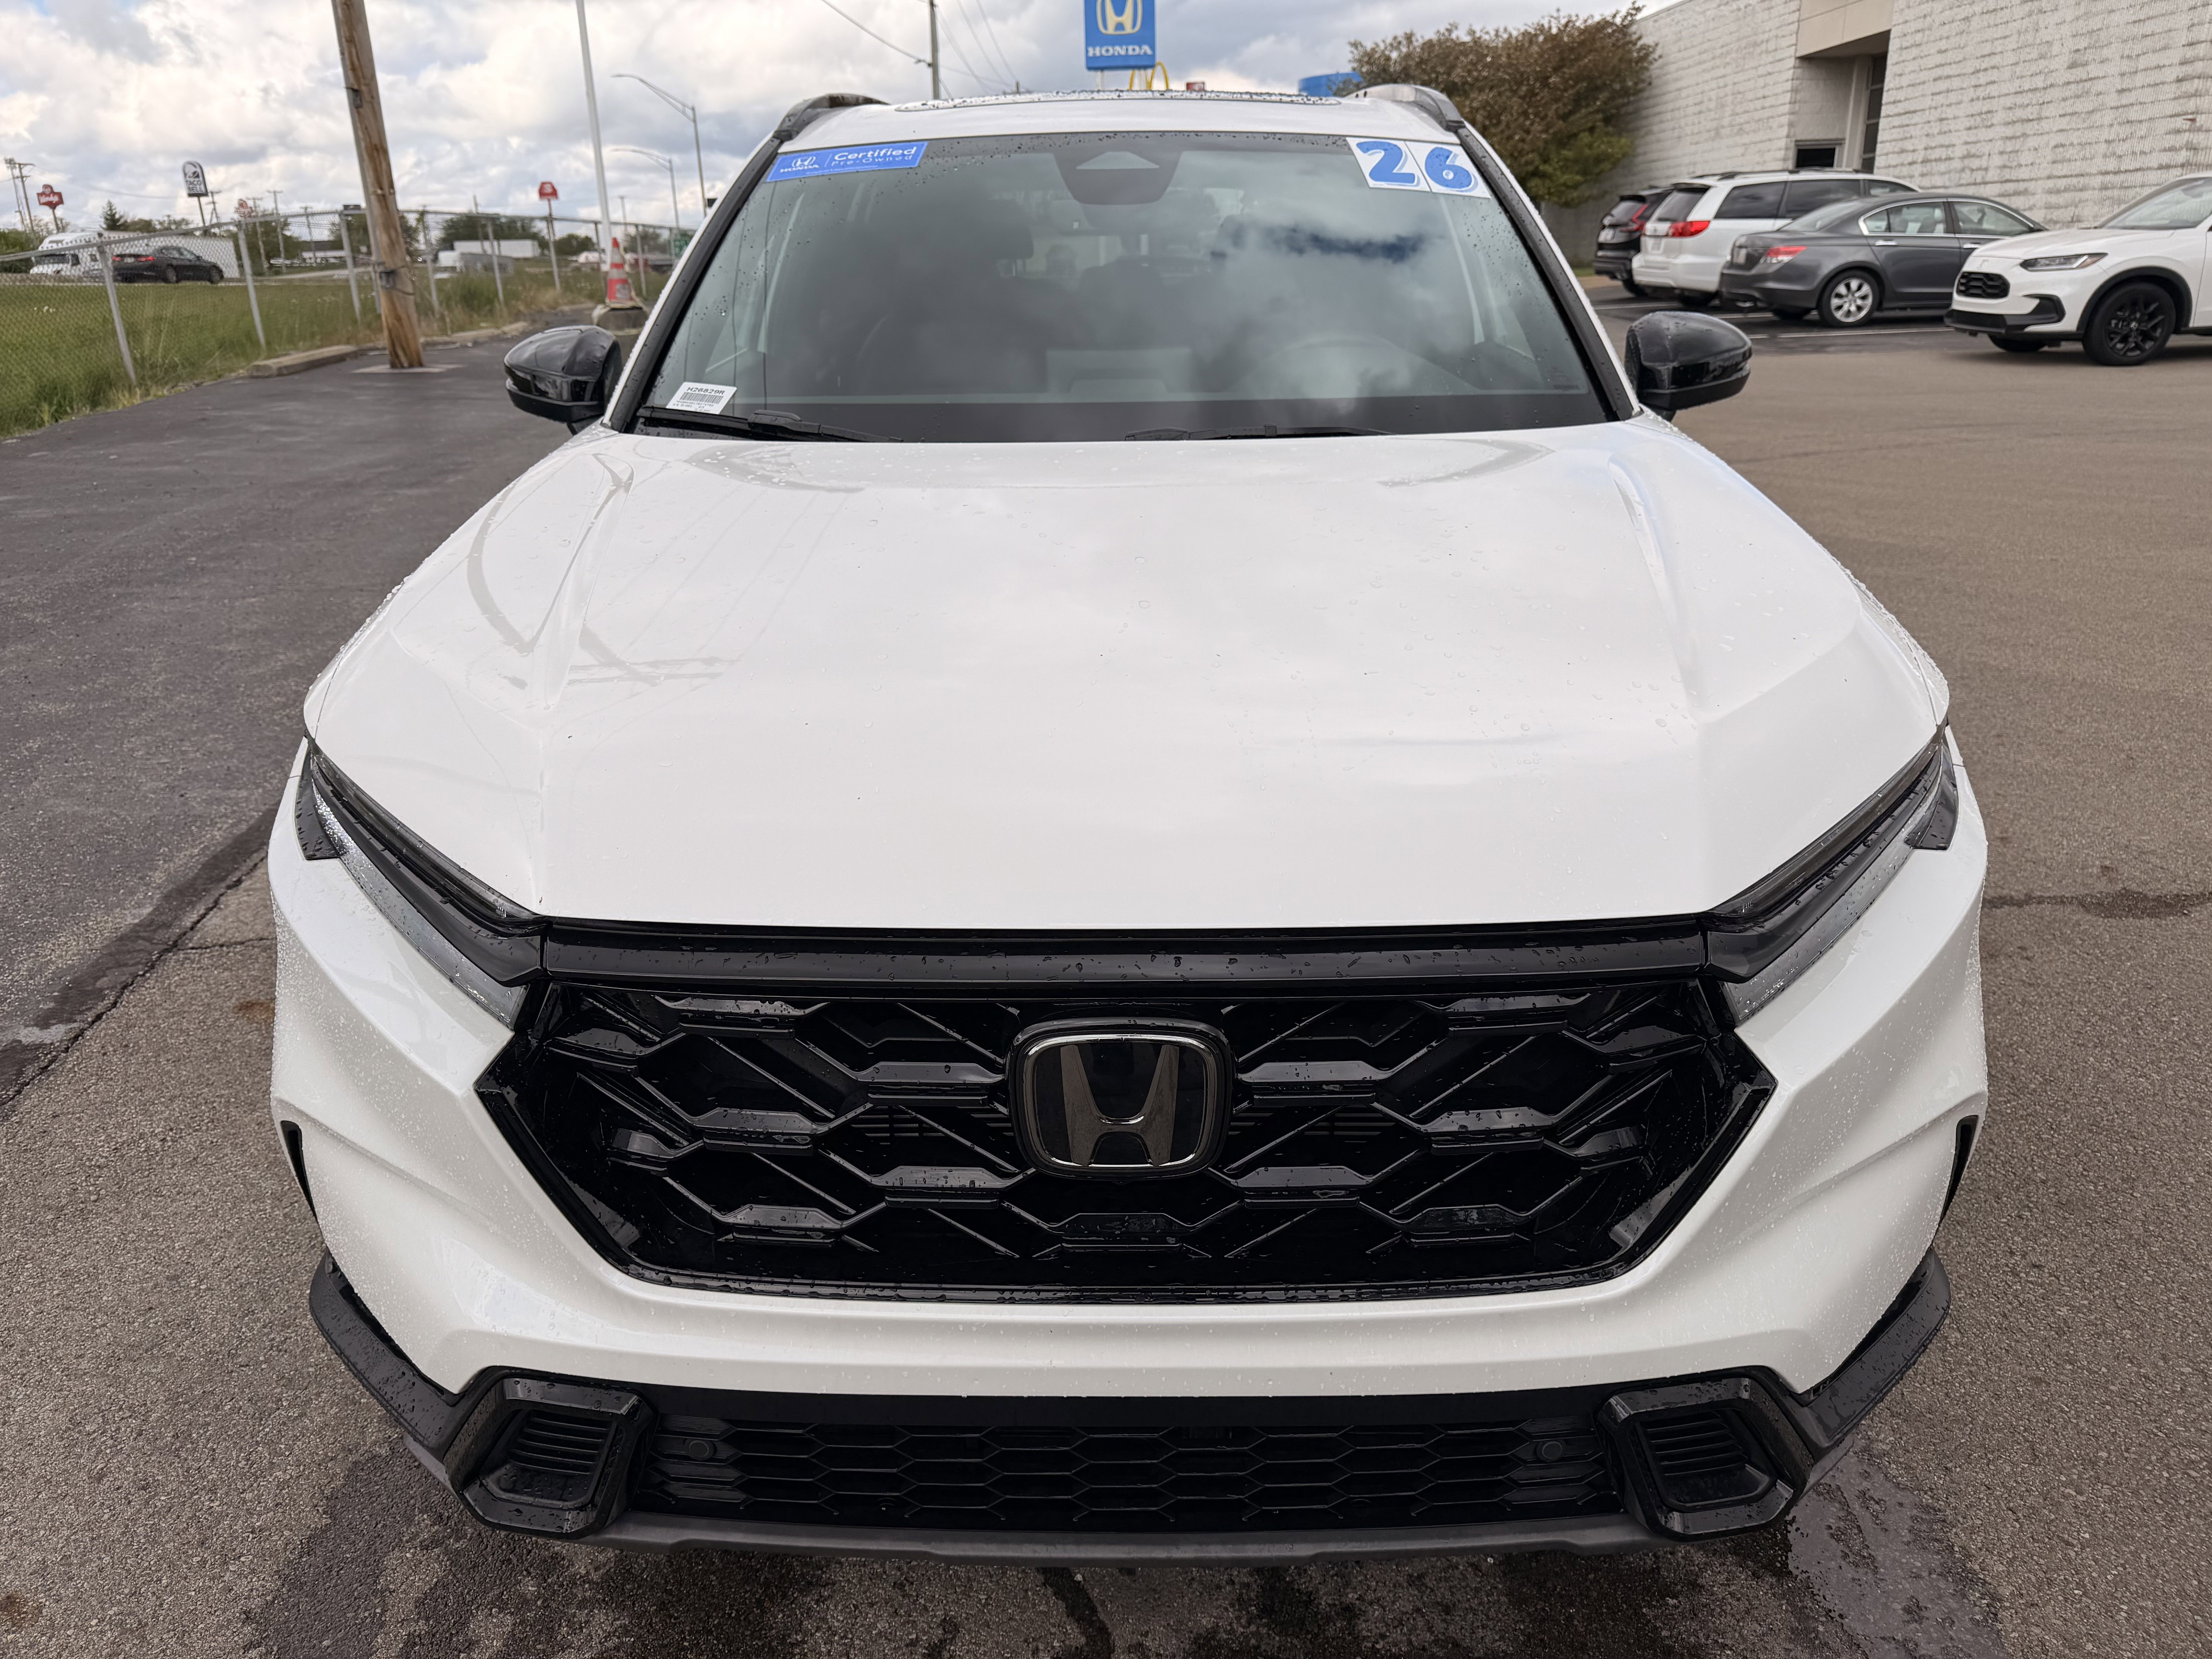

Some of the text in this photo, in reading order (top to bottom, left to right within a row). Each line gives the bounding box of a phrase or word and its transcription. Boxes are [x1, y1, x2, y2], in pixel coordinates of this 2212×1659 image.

[1087, 45, 1153, 57] HONDA
[834, 146, 917, 161] Certified
[831, 155, 913, 167] Pre-Owned
